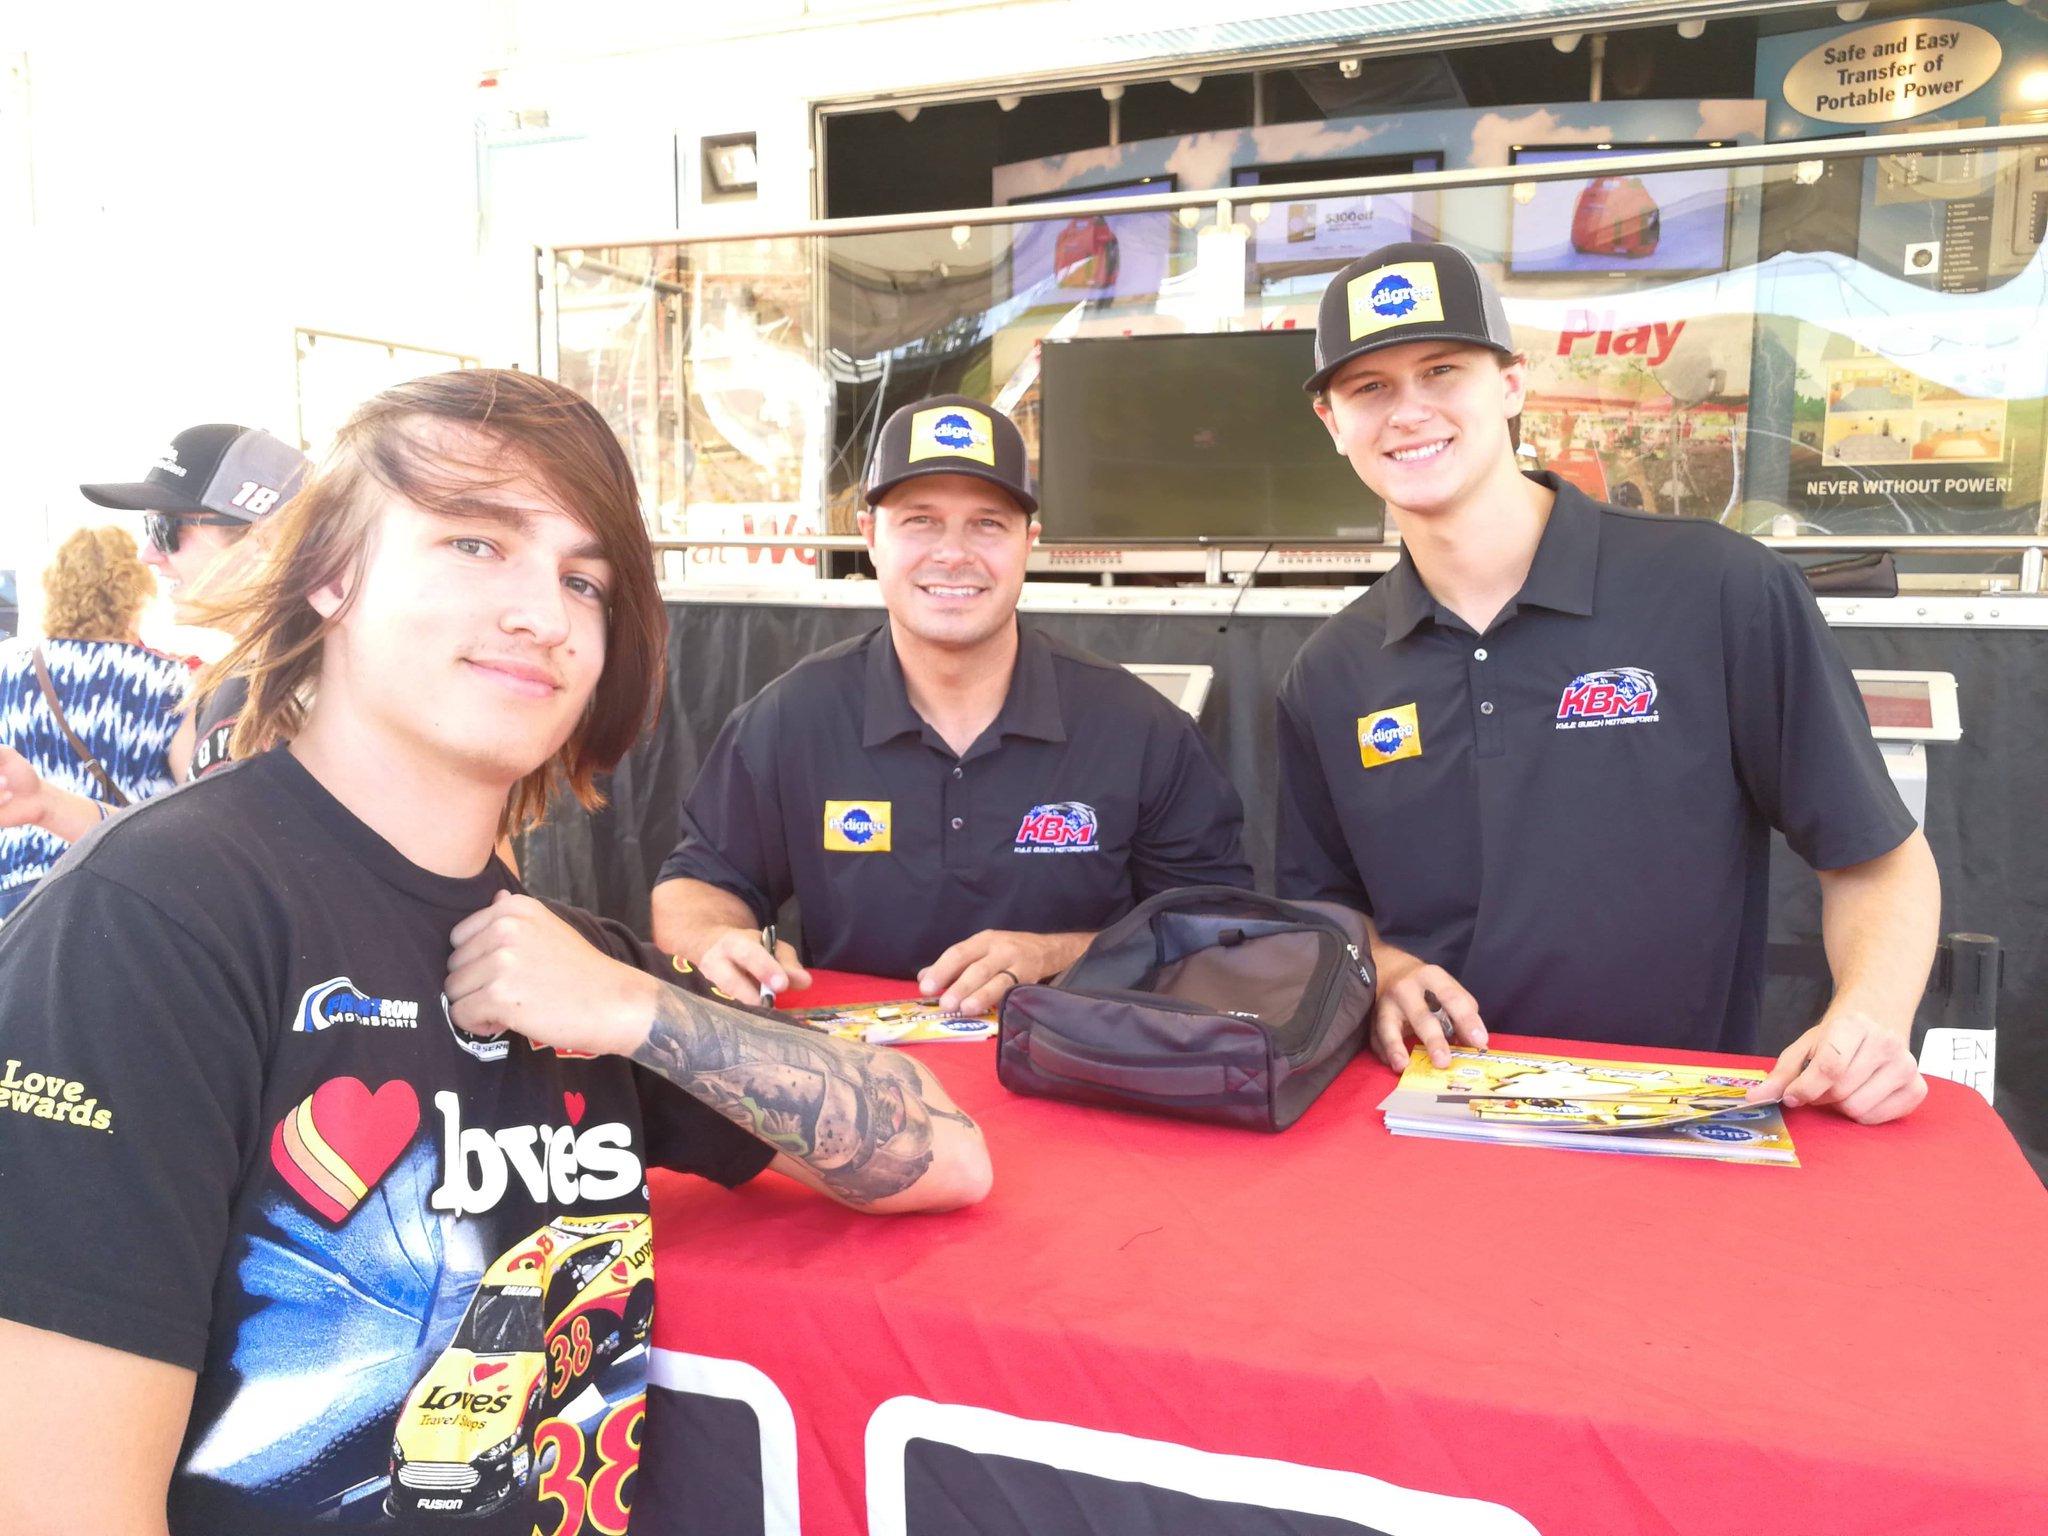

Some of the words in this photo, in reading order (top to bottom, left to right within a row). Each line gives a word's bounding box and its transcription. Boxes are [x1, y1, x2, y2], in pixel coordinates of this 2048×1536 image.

[1823, 43, 1866, 65] Safe
[1872, 37, 1908, 58] and
[1915, 32, 1961, 50] Easy
[1836, 61, 1917, 86] Transfer
[1923, 54, 1944, 74] of
[1816, 86, 1896, 112] Portable
[1903, 78, 1965, 99] Power
[1556, 309, 1687, 367] Play
[231, 480, 280, 515] 18
[1806, 480, 1858, 496] NEVER
[1863, 478, 1941, 495] WITHOUT
[1944, 477, 2013, 494] POWER!
[1556, 682, 1652, 719] KBM
[1361, 724, 1413, 746] Pedigree
[1015, 813, 1094, 846] KBM
[380, 999, 418, 1020] ROW
[0, 1087, 113, 1130] ewards
[551, 1315, 593, 1399] 38
[420, 1413, 458, 1426] Travel
[531, 1394, 648, 1536] 38
[417, 1498, 463, 1511] FUSION
